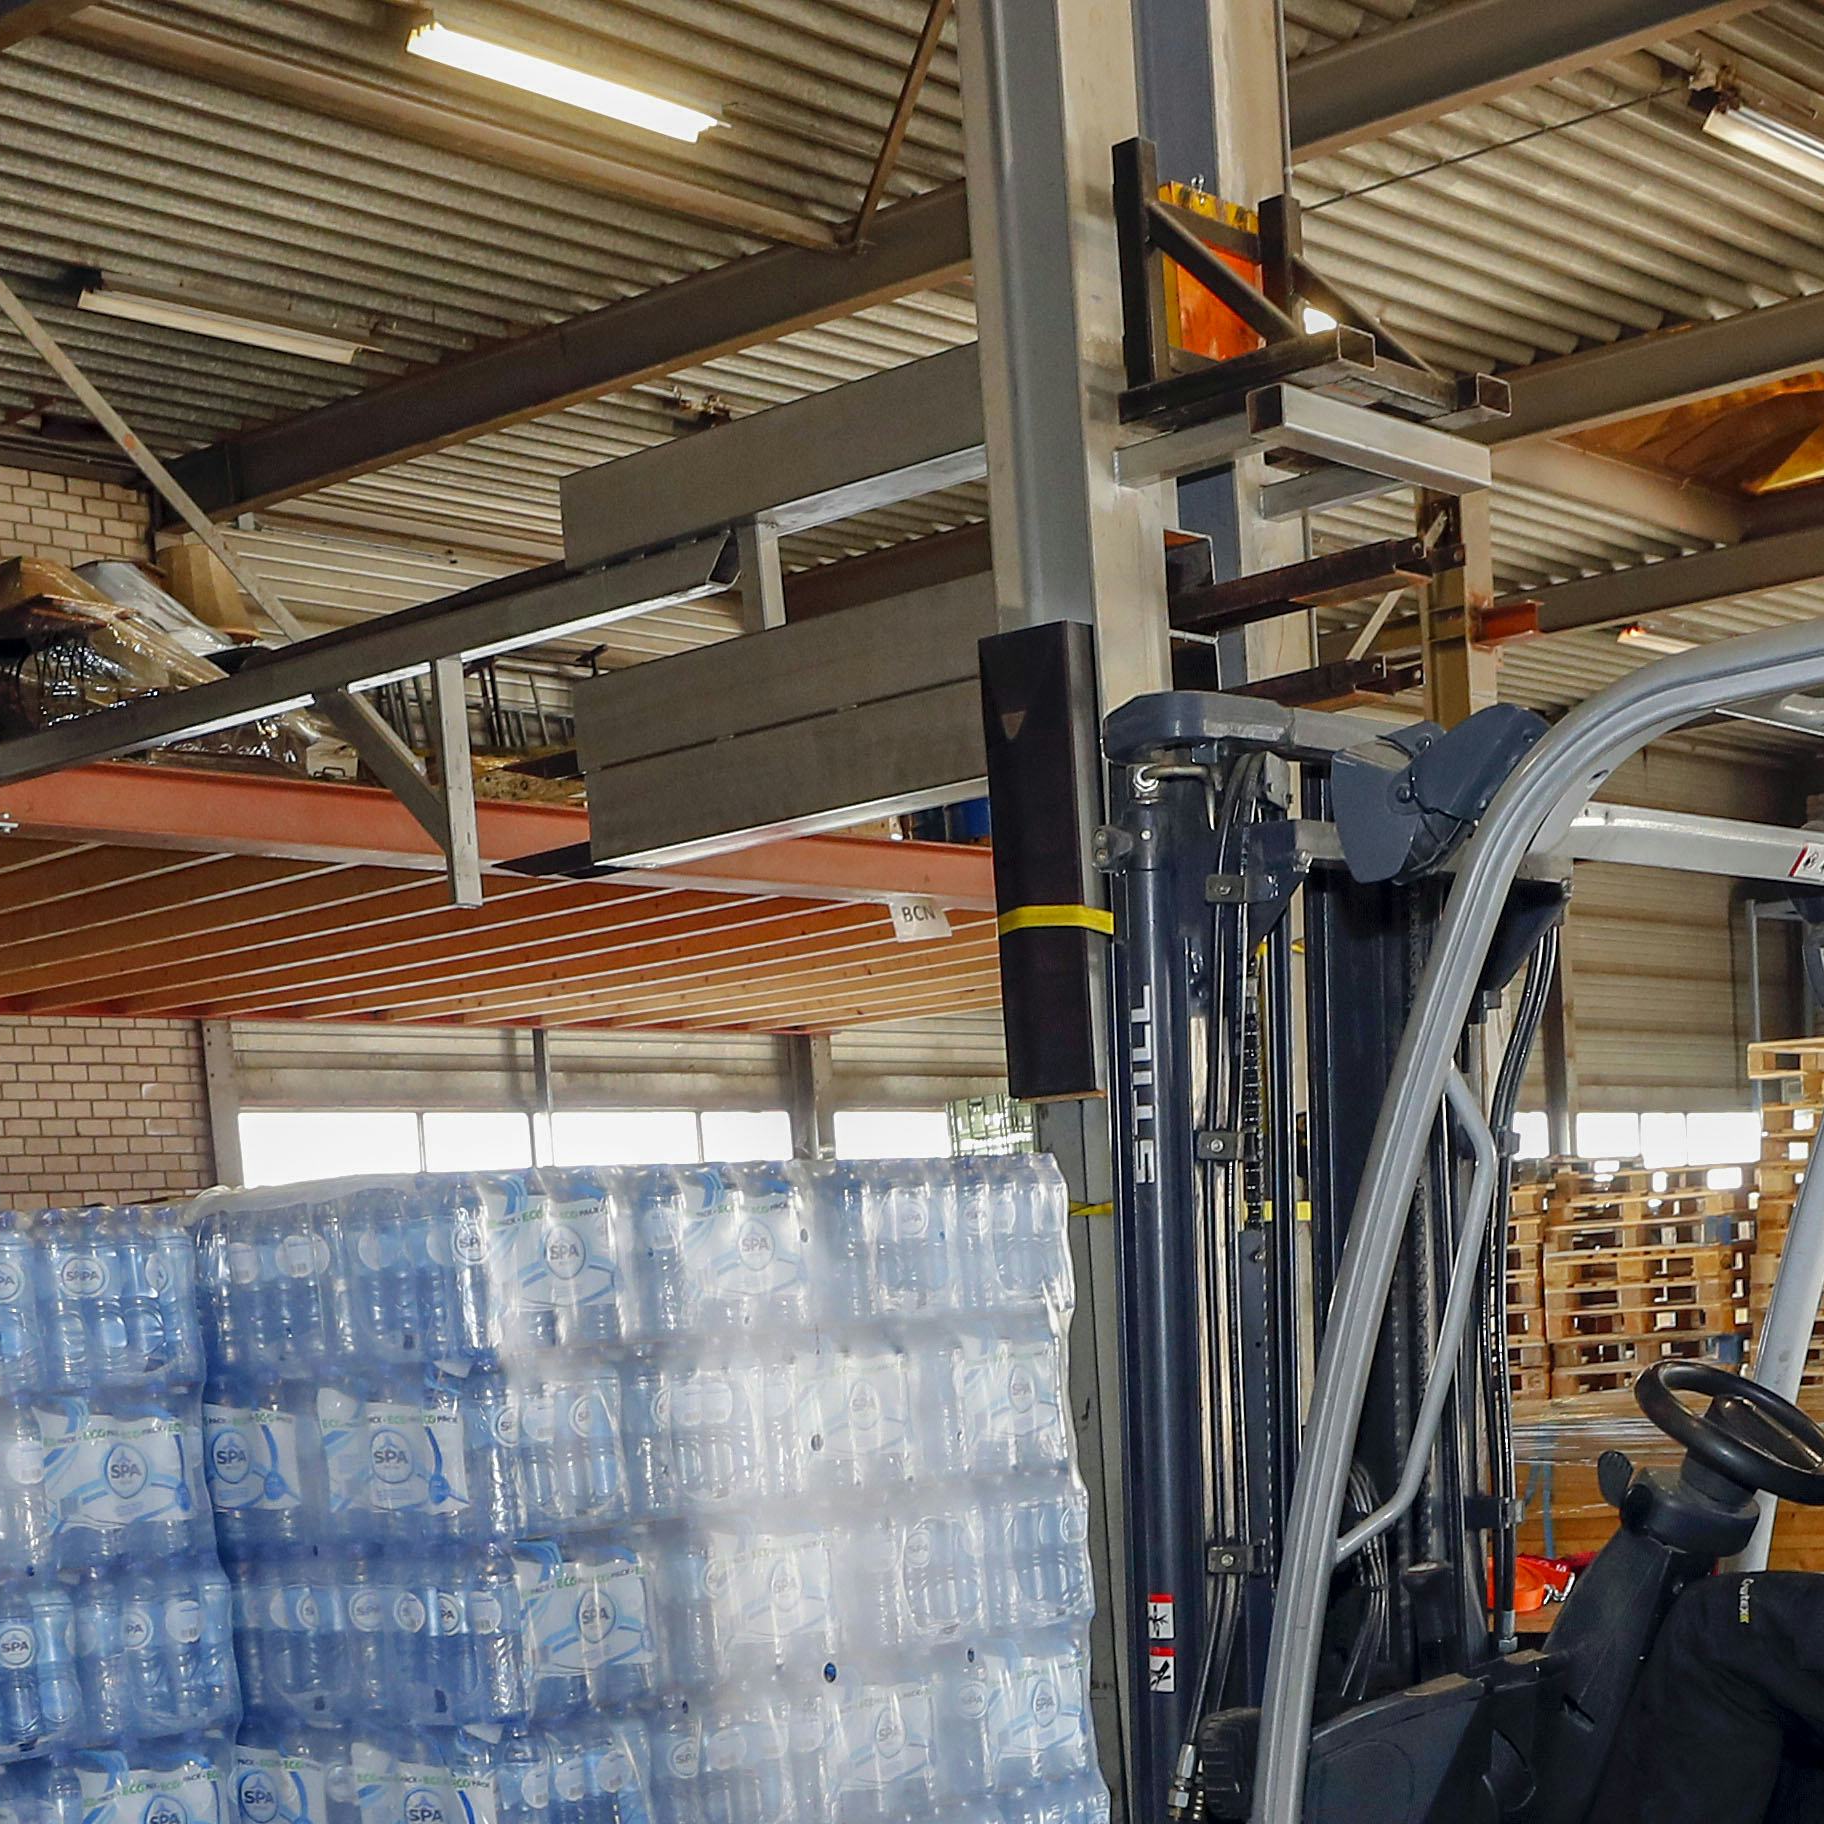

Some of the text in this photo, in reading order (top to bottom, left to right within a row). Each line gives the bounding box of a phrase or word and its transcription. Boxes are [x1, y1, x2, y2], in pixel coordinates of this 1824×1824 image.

[901, 905, 936, 923] BCN
[1130, 984, 1155, 1184] STILL
[741, 1237, 771, 1252] SPA
[549, 1245, 579, 1261] SPA
[216, 1450, 246, 1465] SPA
[375, 1449, 409, 1465] SPA
[111, 1464, 141, 1480] SPA
[581, 1608, 610, 1625] SPA
[0, 1640, 29, 1653] SPA
[243, 1790, 273, 1805] SPA
[408, 1806, 444, 1823] SPA
